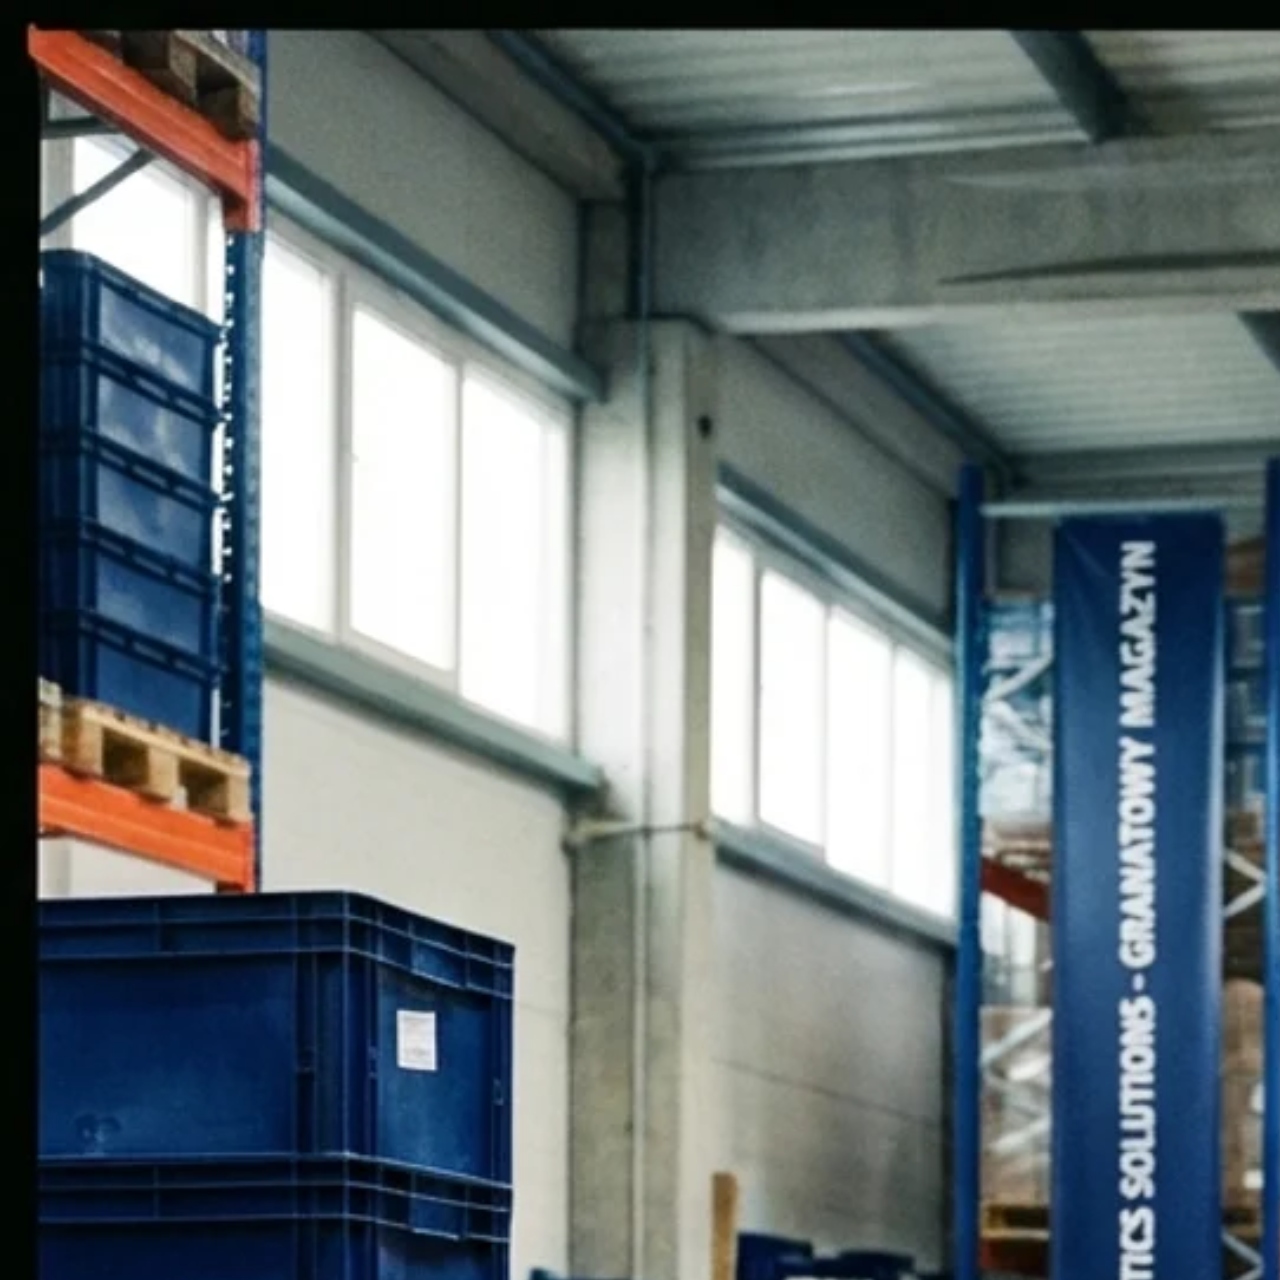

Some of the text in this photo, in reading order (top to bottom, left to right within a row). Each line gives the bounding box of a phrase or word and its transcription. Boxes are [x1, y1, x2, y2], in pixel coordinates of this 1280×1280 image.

[1118, 541, 1156, 728] MAGAZYN
[1116, 735, 1157, 969] GRANATOWY
[1117, 995, 1156, 1199] SOLUTIONS
